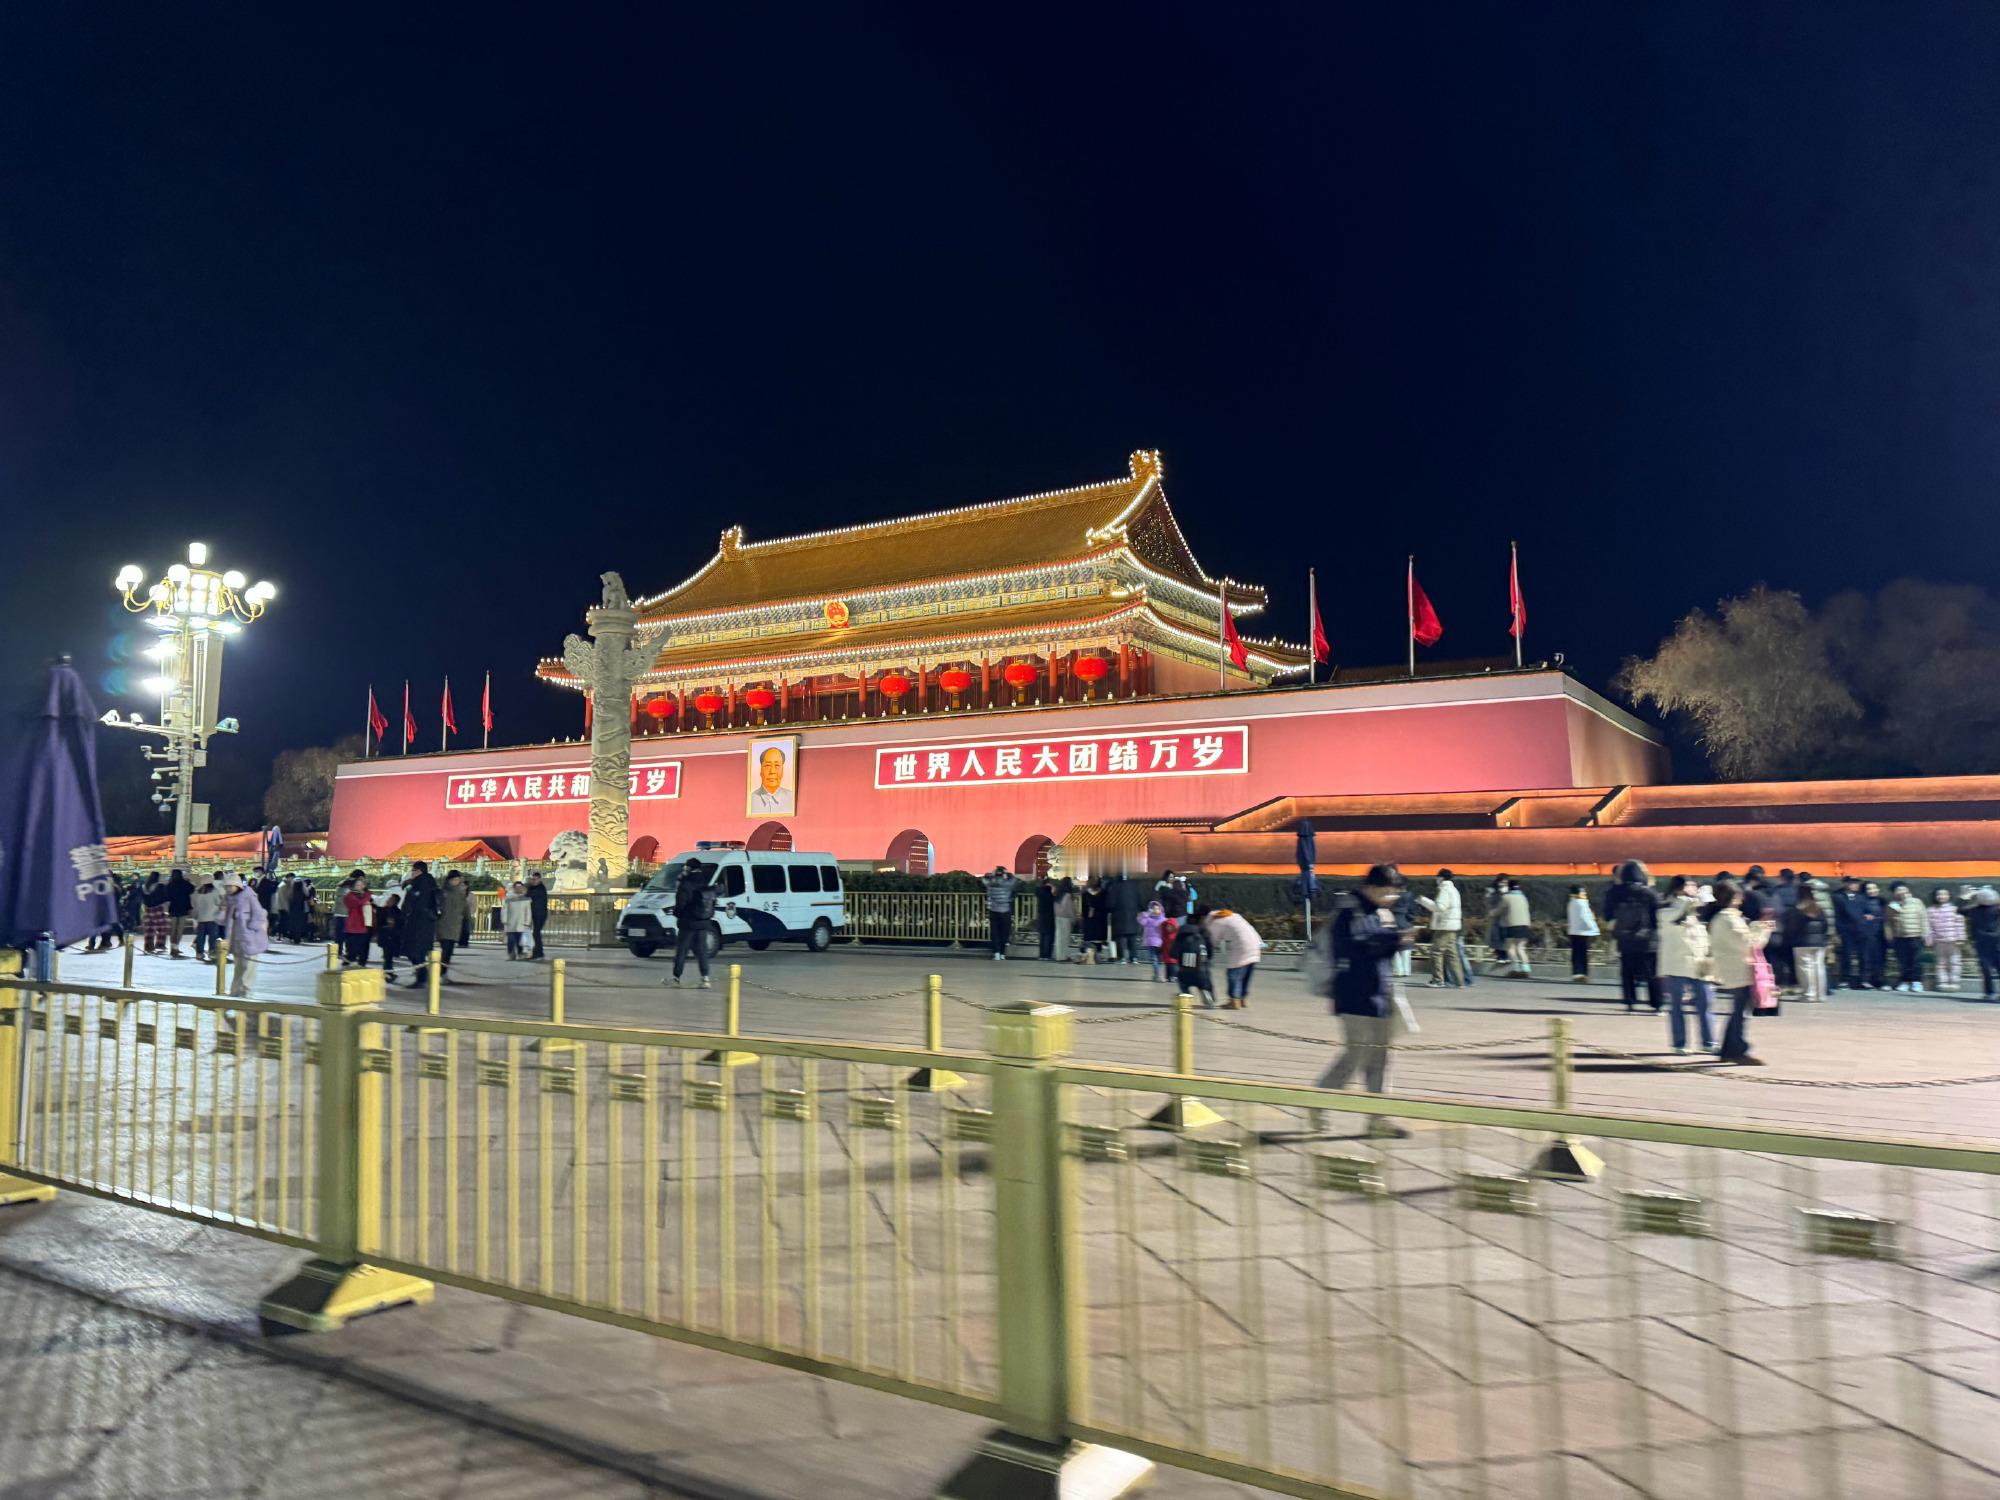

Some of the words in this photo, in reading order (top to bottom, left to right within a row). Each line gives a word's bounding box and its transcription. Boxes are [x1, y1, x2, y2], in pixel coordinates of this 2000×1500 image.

[893, 736, 1223, 780] 世界人民大团结万岁
[457, 769, 666, 802] 中华人民共和万岁
